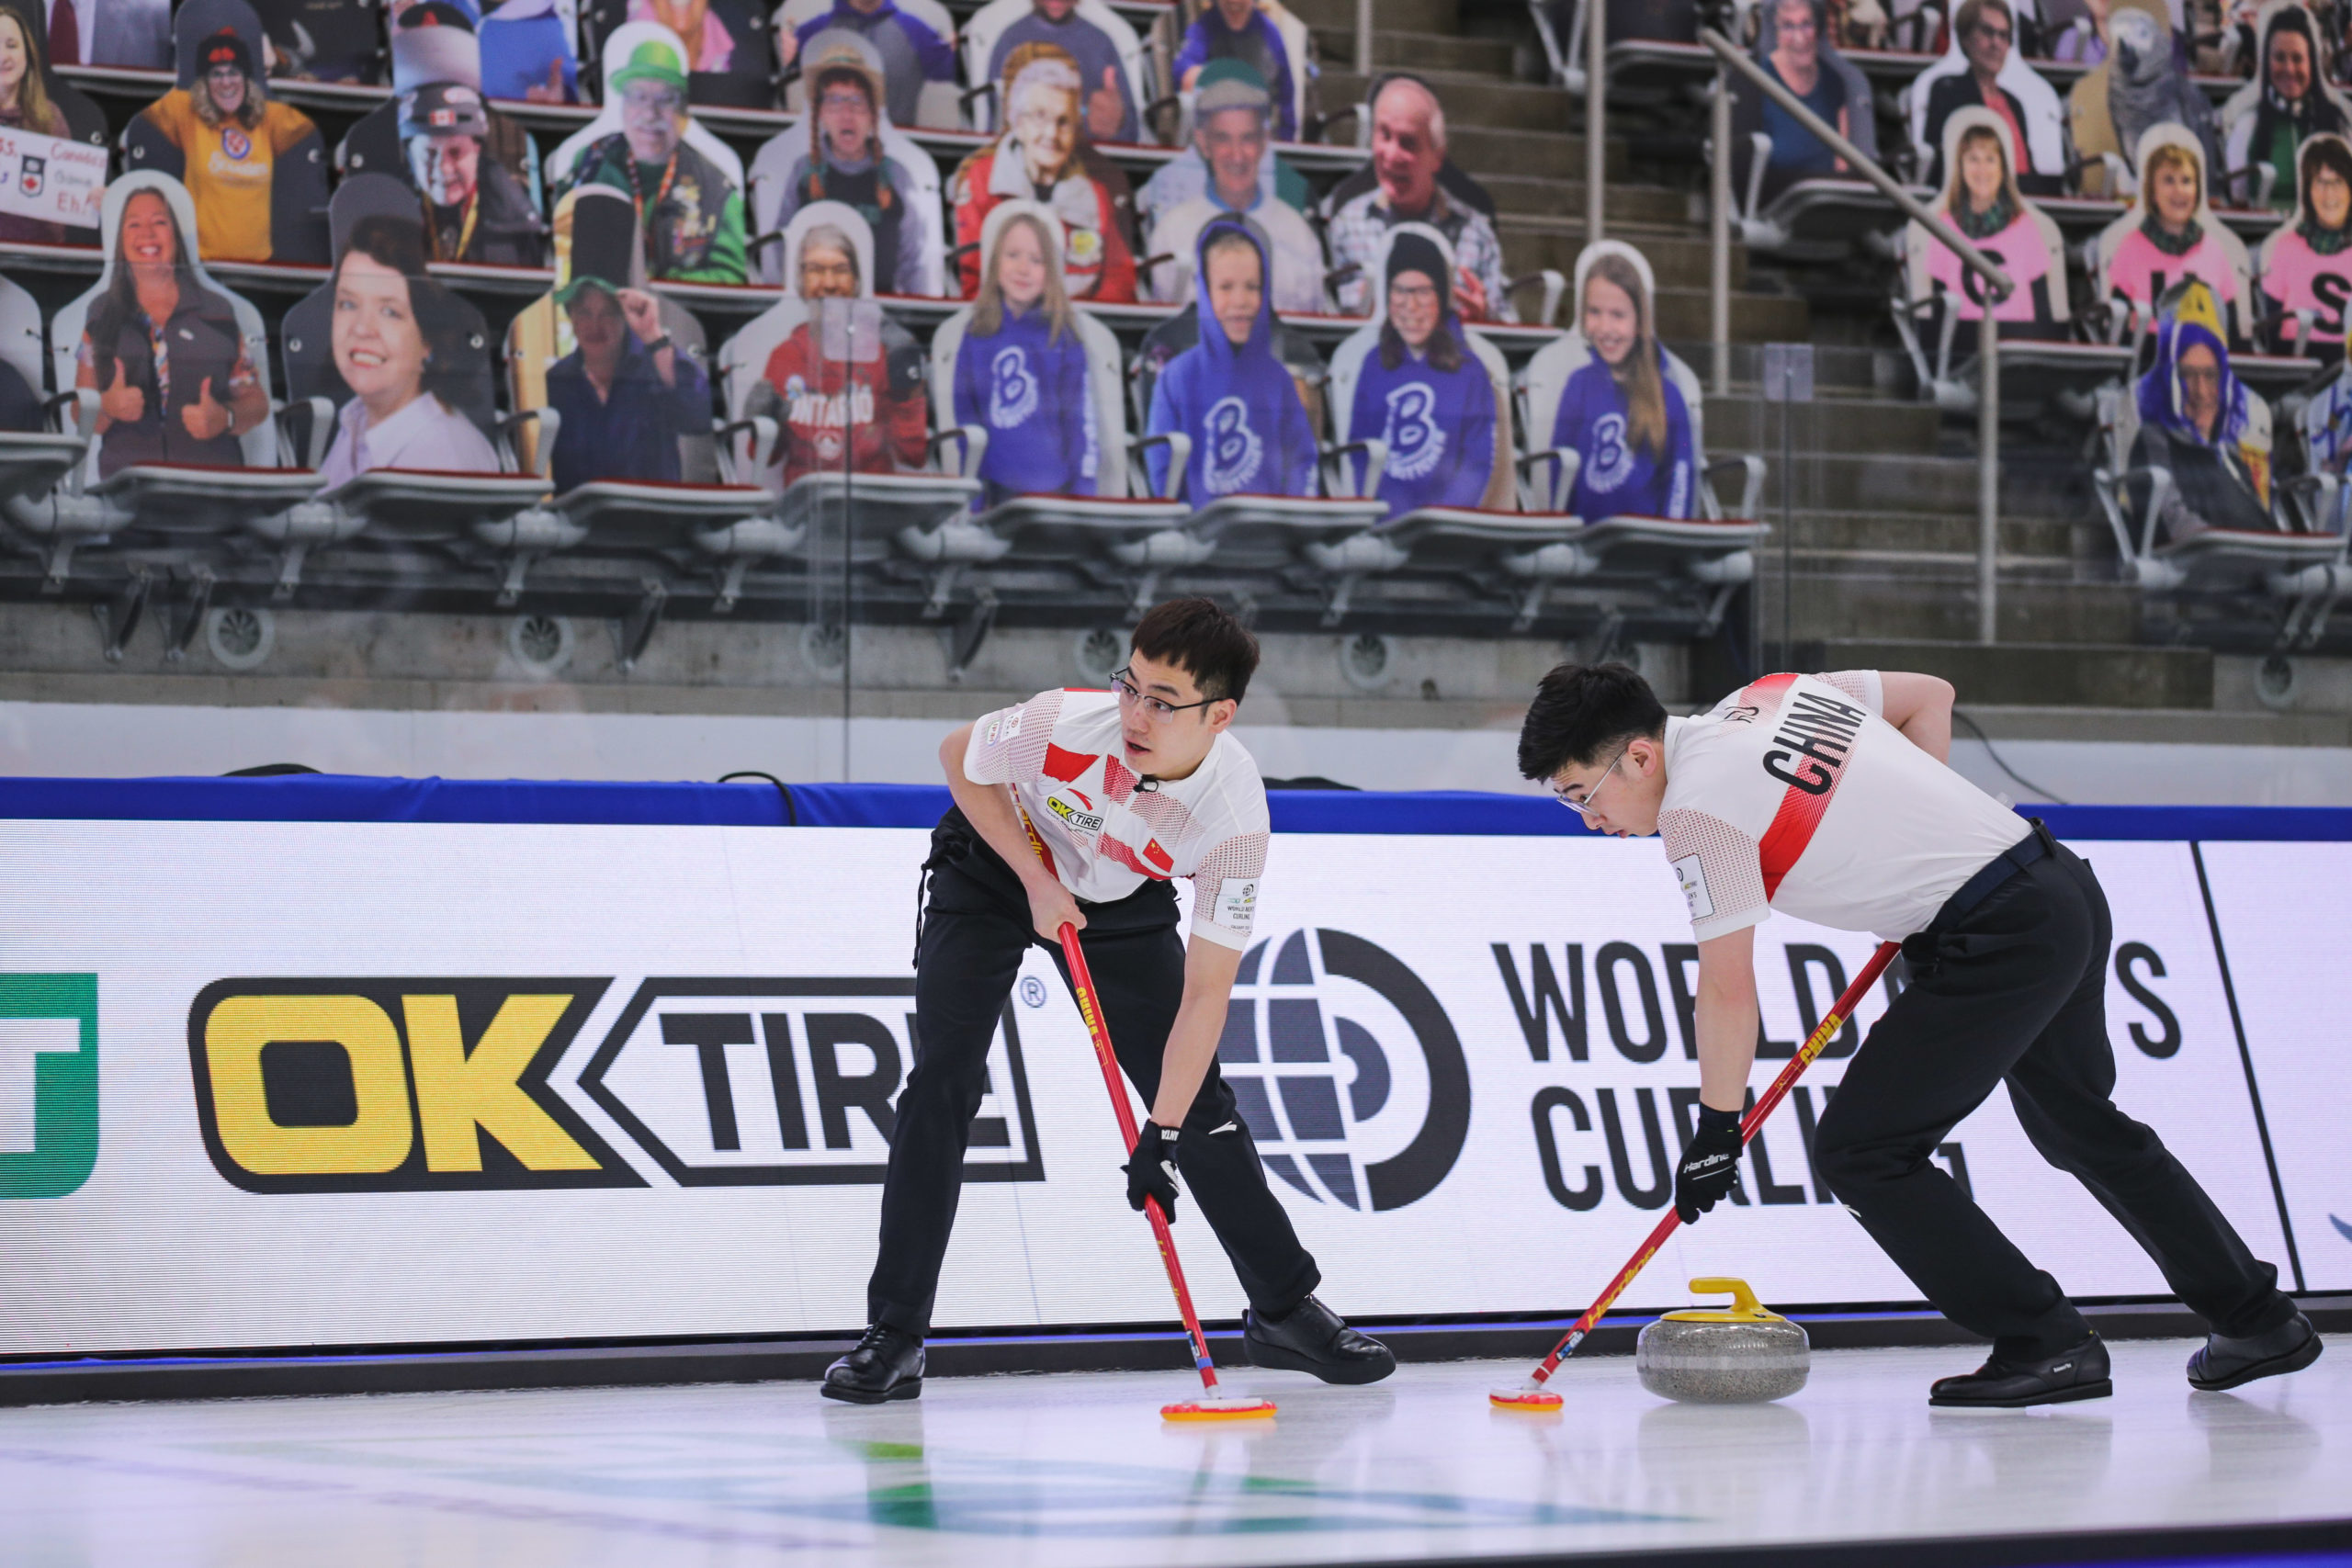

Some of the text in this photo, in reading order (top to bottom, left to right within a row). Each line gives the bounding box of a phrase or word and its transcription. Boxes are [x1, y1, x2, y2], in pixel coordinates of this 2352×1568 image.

[1763, 692, 1867, 795] CHINA
[1047, 796, 1101, 829] OK TIRE
[1076, 986, 1100, 1036] CHINA
[1799, 1012, 1844, 1066] CHINA
[204, 993, 604, 1175] OK
[1682, 1153, 1730, 1174] Hardline
[1588, 1246, 1656, 1329] Hardline
